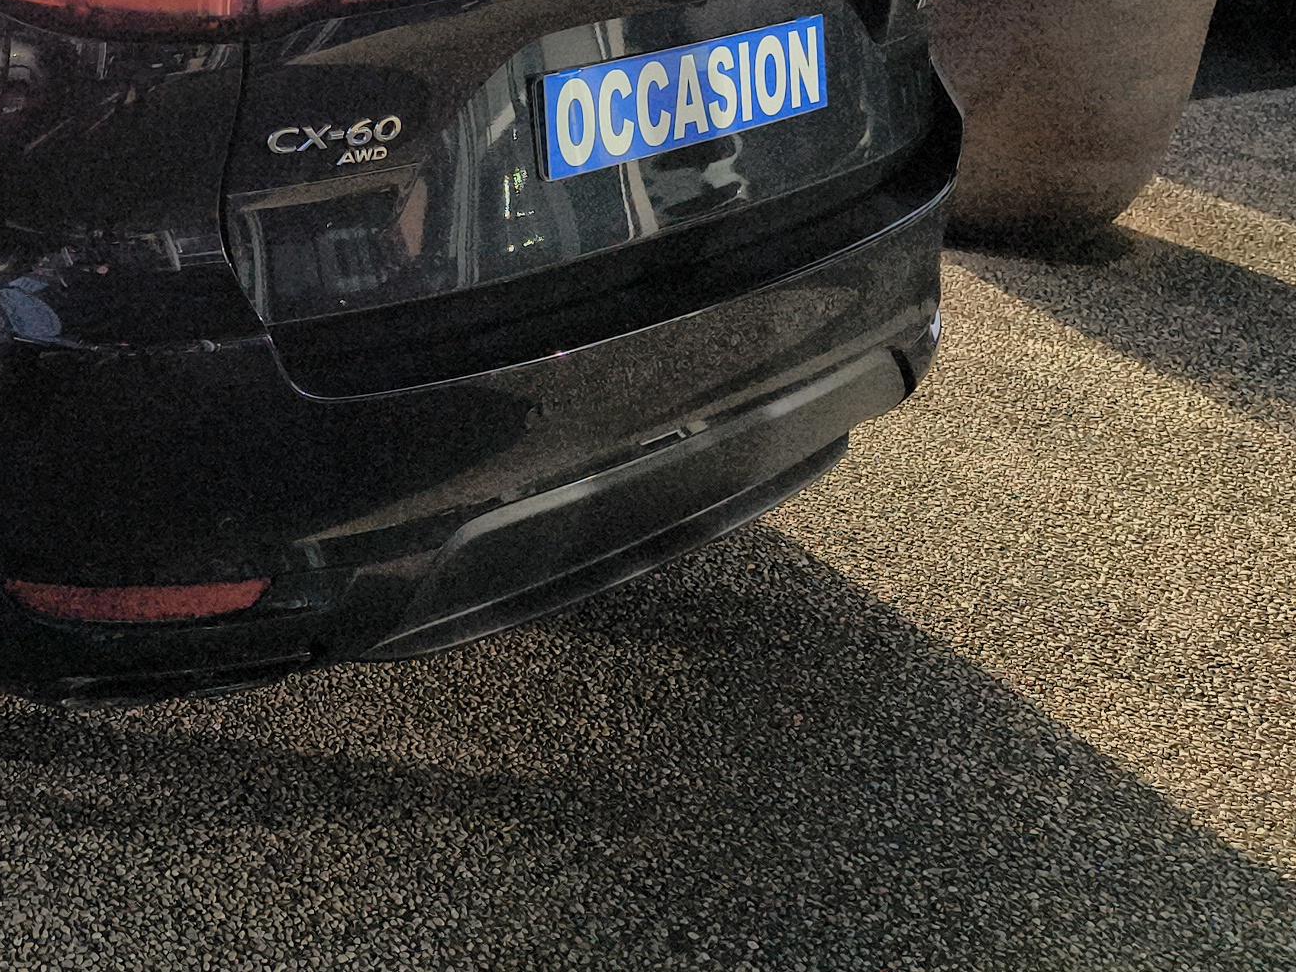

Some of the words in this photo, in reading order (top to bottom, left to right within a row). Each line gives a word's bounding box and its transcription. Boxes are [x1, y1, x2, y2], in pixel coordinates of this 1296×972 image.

[556, 25, 821, 167] OCCASION
[267, 114, 403, 155] CX-60
[336, 145, 388, 166] AWD
